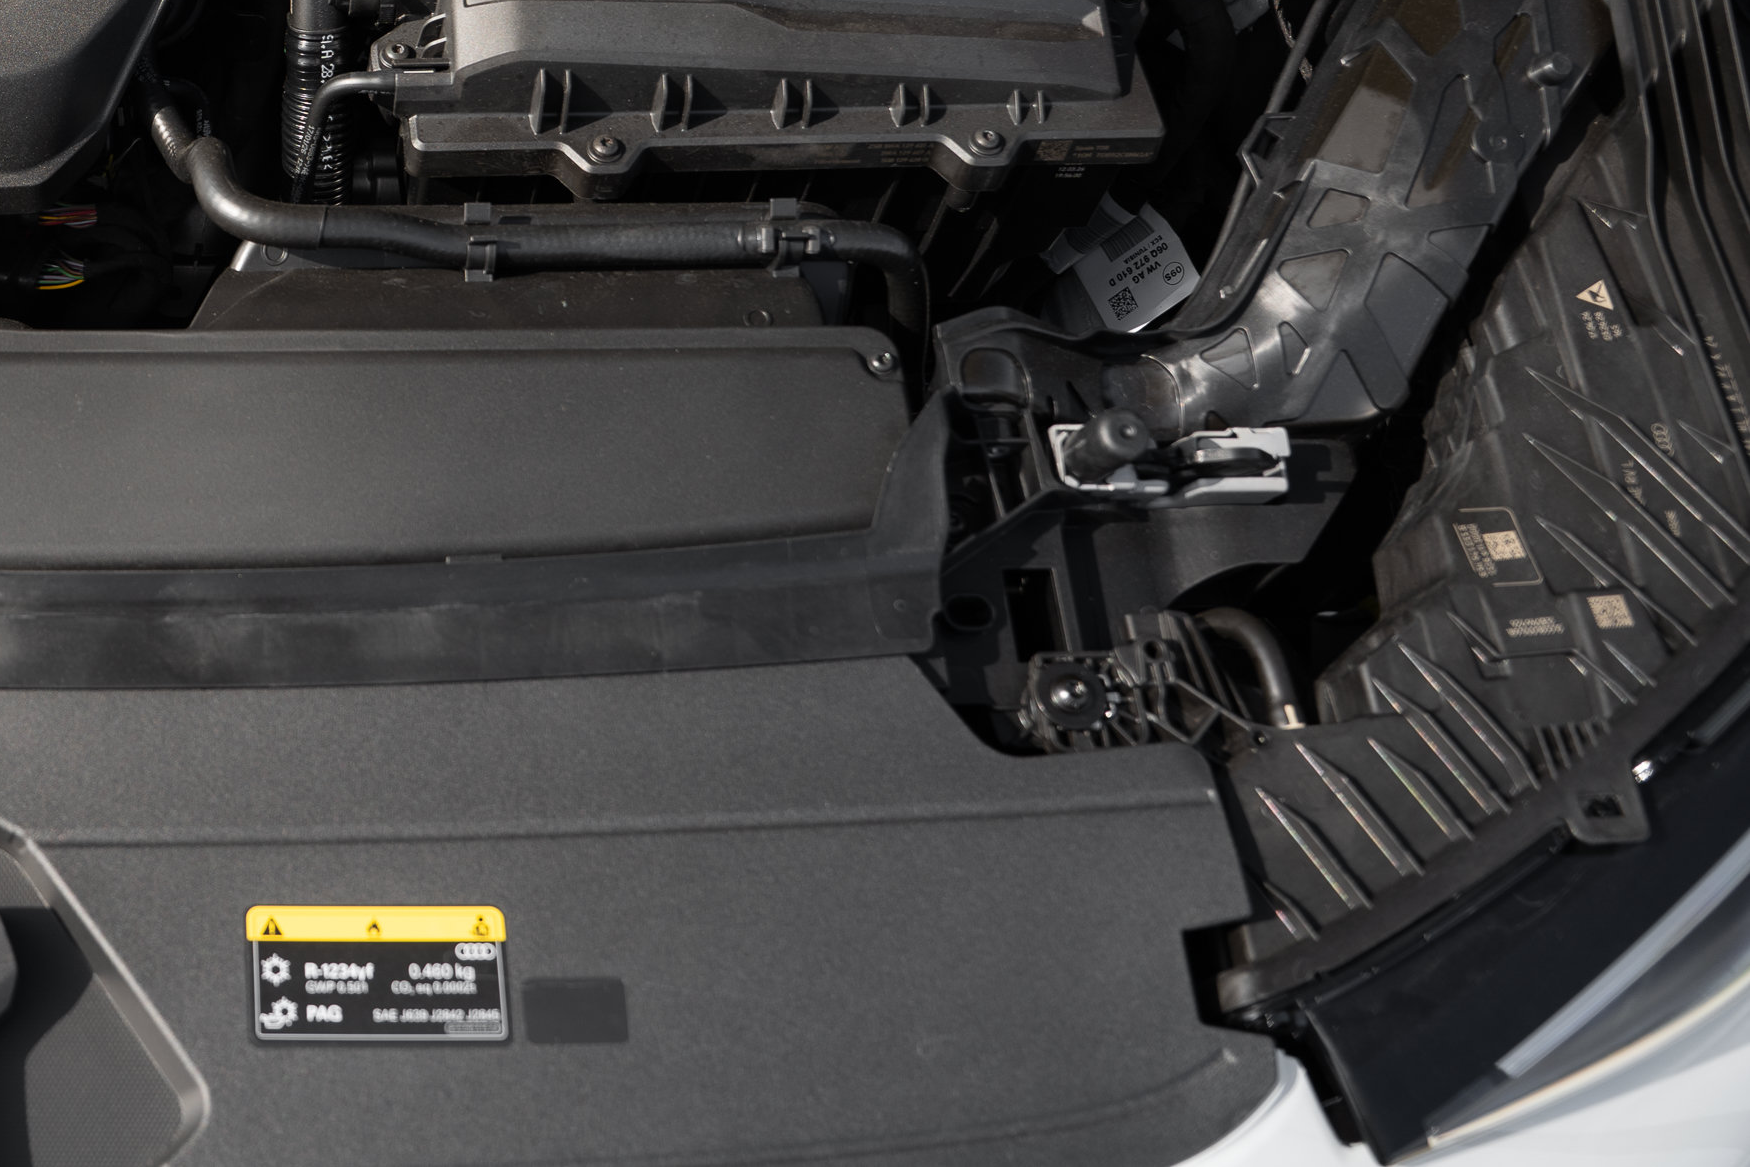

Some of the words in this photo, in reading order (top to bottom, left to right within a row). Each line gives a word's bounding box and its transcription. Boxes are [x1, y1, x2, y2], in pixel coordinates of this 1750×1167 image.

[1123, 246, 1147, 264] TUNISIA
[1149, 242, 1169, 259] 06Q
[1132, 254, 1150, 271] 972
[1146, 260, 1161, 275] VW
[1115, 266, 1133, 281] 610
[1131, 271, 1145, 284] AG
[1164, 265, 1182, 282] 09S
[304, 962, 375, 981] R-1234yf
[455, 963, 476, 982] kg
[305, 981, 336, 994] GWP
[306, 1004, 343, 1022] PAG
[373, 1008, 399, 1022] SAE
